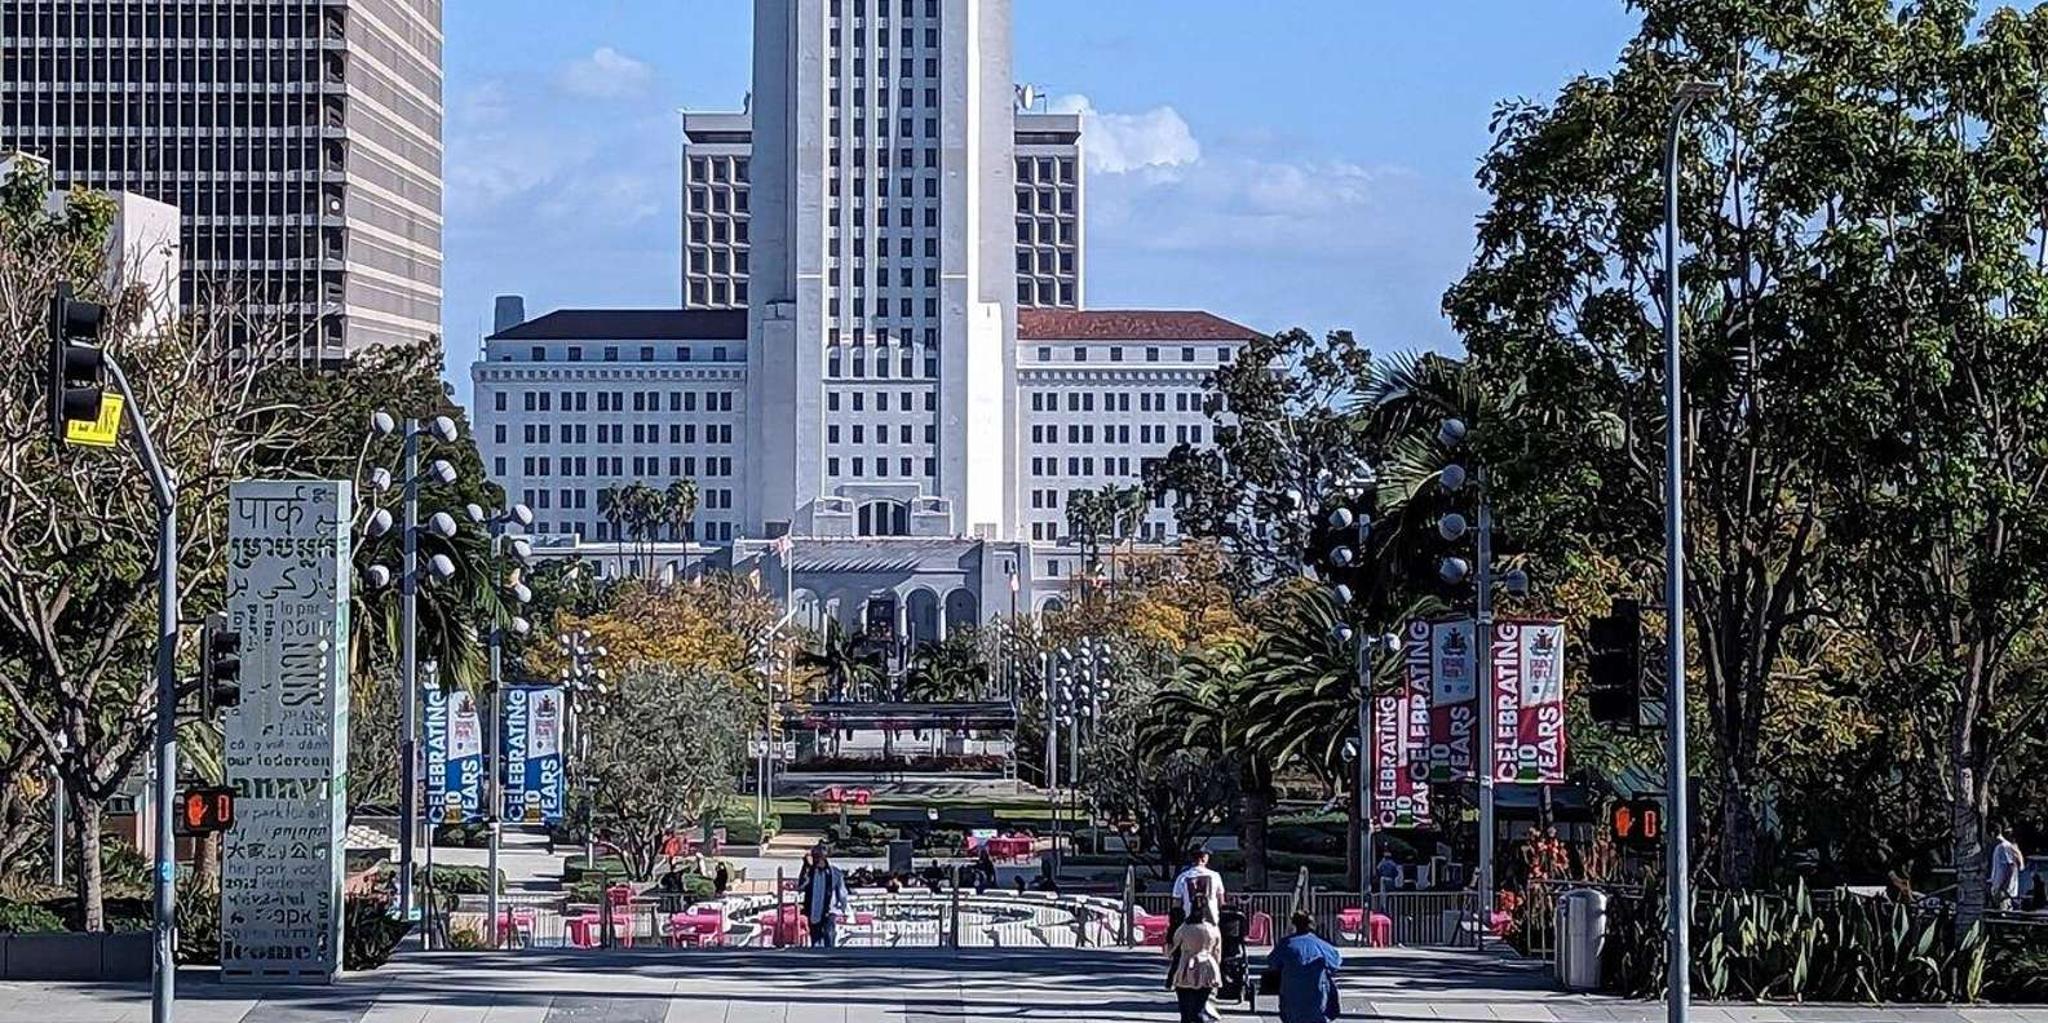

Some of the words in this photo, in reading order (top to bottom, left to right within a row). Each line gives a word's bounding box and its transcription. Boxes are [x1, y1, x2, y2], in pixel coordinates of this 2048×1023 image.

[1407, 621, 1430, 780] CELEBRATING
[1451, 705, 1475, 781] YEARS
[1495, 621, 1518, 780] CELEBRATING
[1538, 707, 1562, 782] YEARS
[427, 690, 447, 823] CELEBRATING
[461, 759, 482, 823] YEARS
[507, 689, 526, 821] CELEBRATING
[541, 759, 563, 821] YEARS
[1377, 696, 1397, 828] CELEBRATING
[1517, 744, 1538, 770] 10
